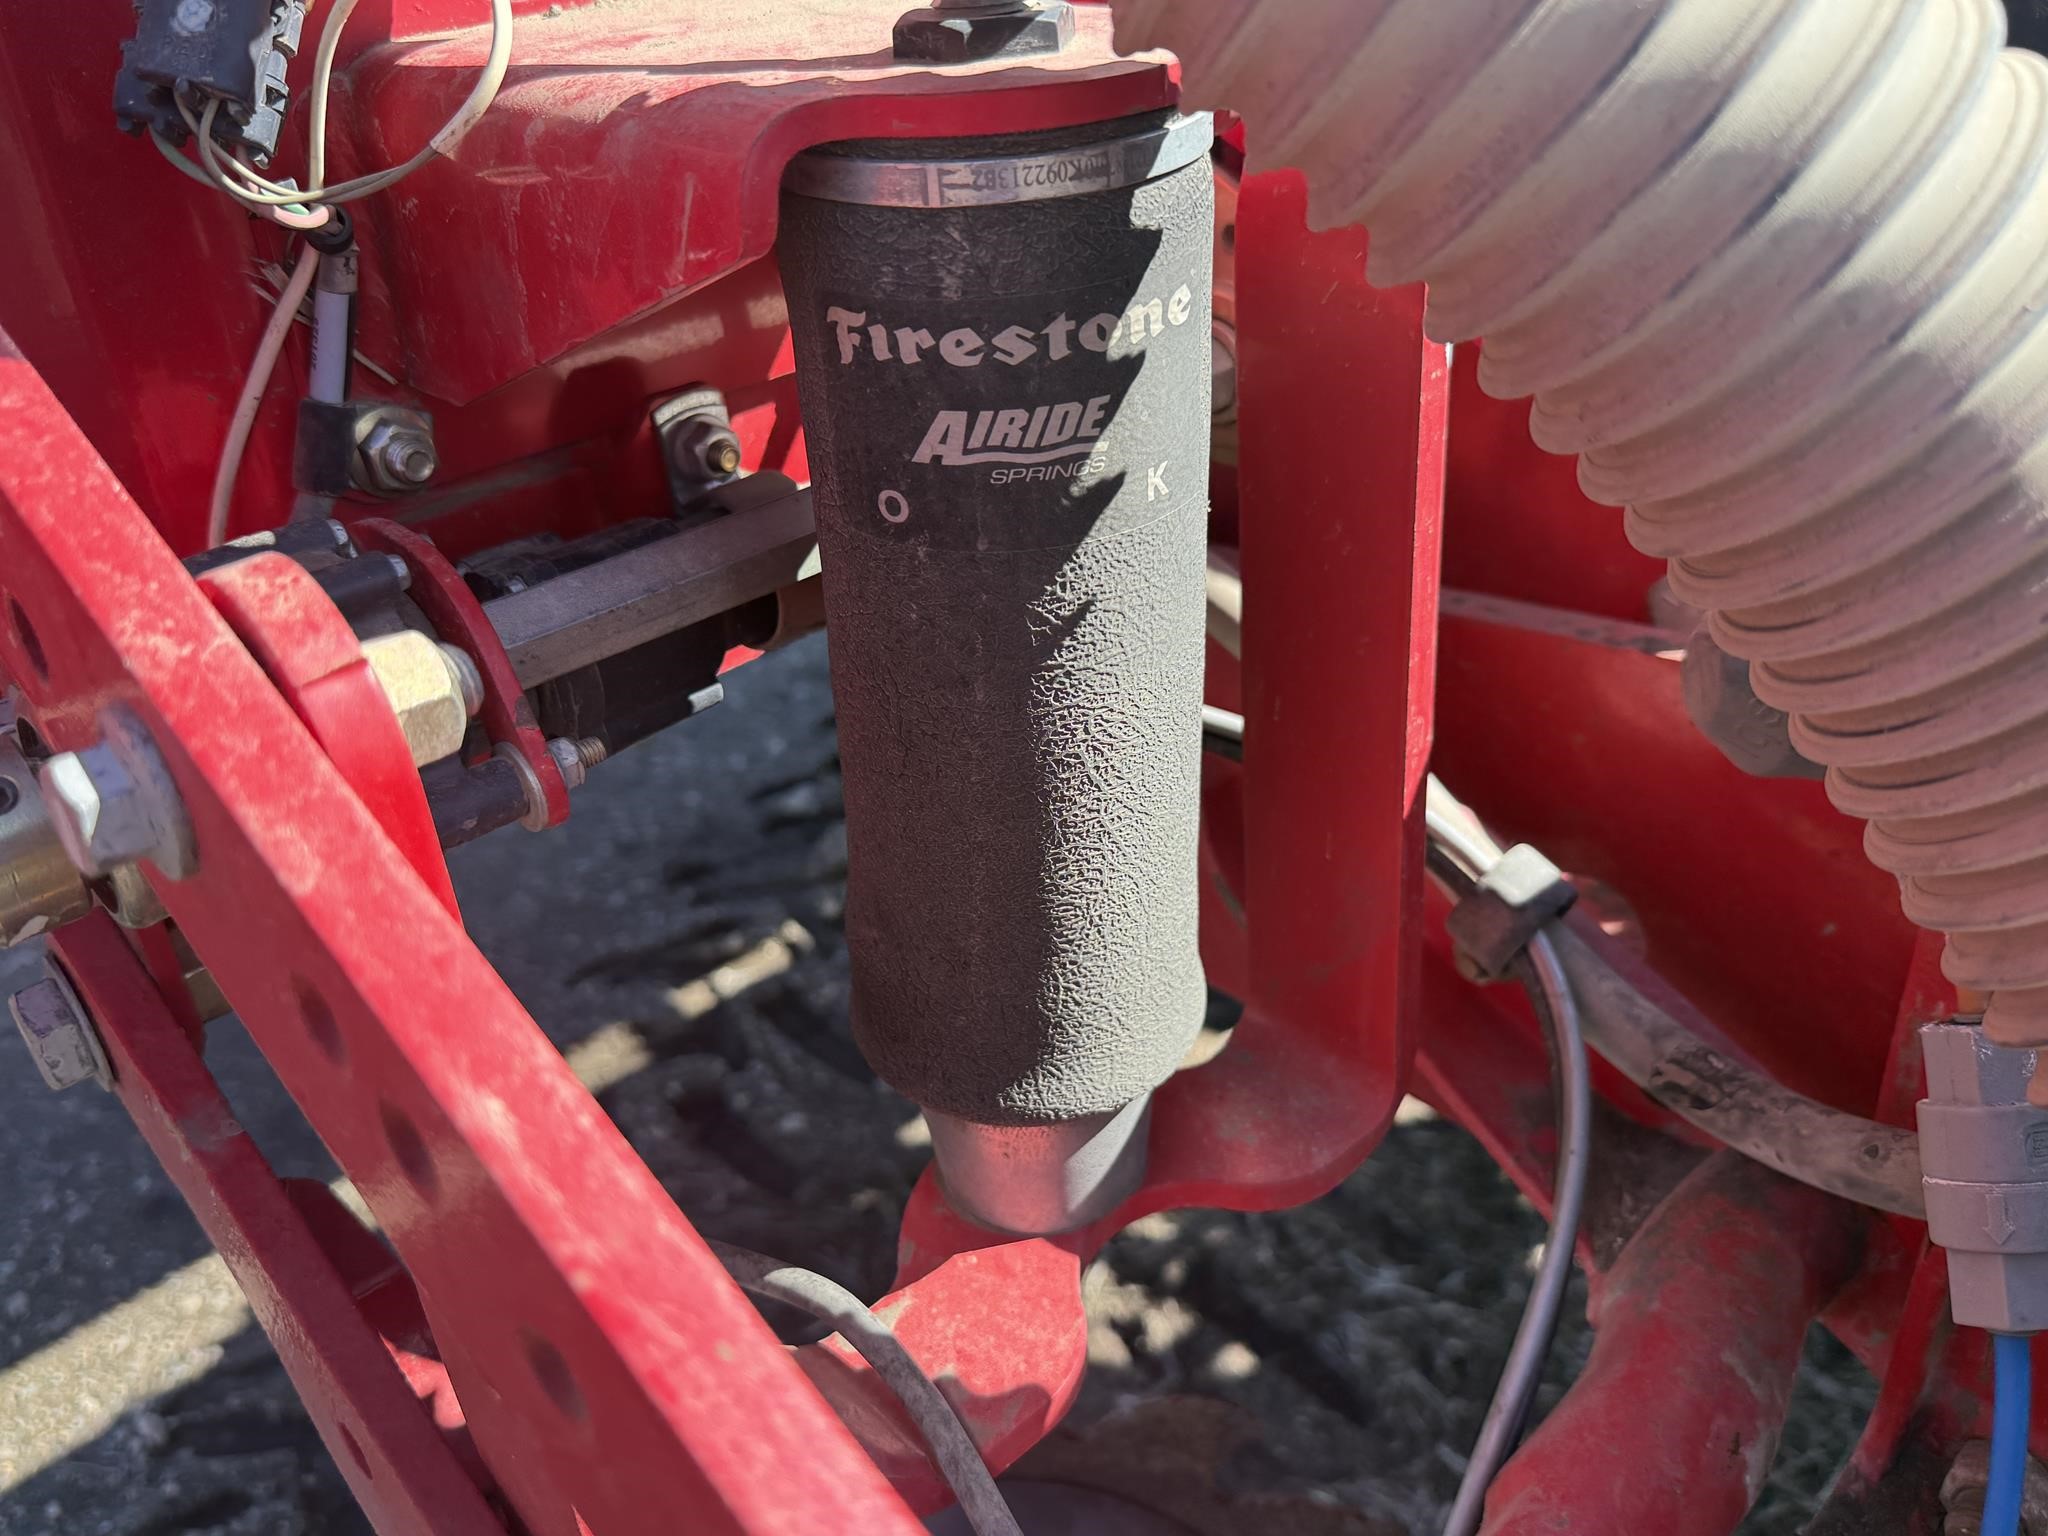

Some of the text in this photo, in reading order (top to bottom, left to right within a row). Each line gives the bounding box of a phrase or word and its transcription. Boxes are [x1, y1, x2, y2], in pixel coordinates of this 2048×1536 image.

[826, 283, 1192, 367] Firestone
[911, 395, 1111, 466] AIRIDE
[989, 456, 1107, 486] SPRINGS
[1147, 460, 1170, 502] K
